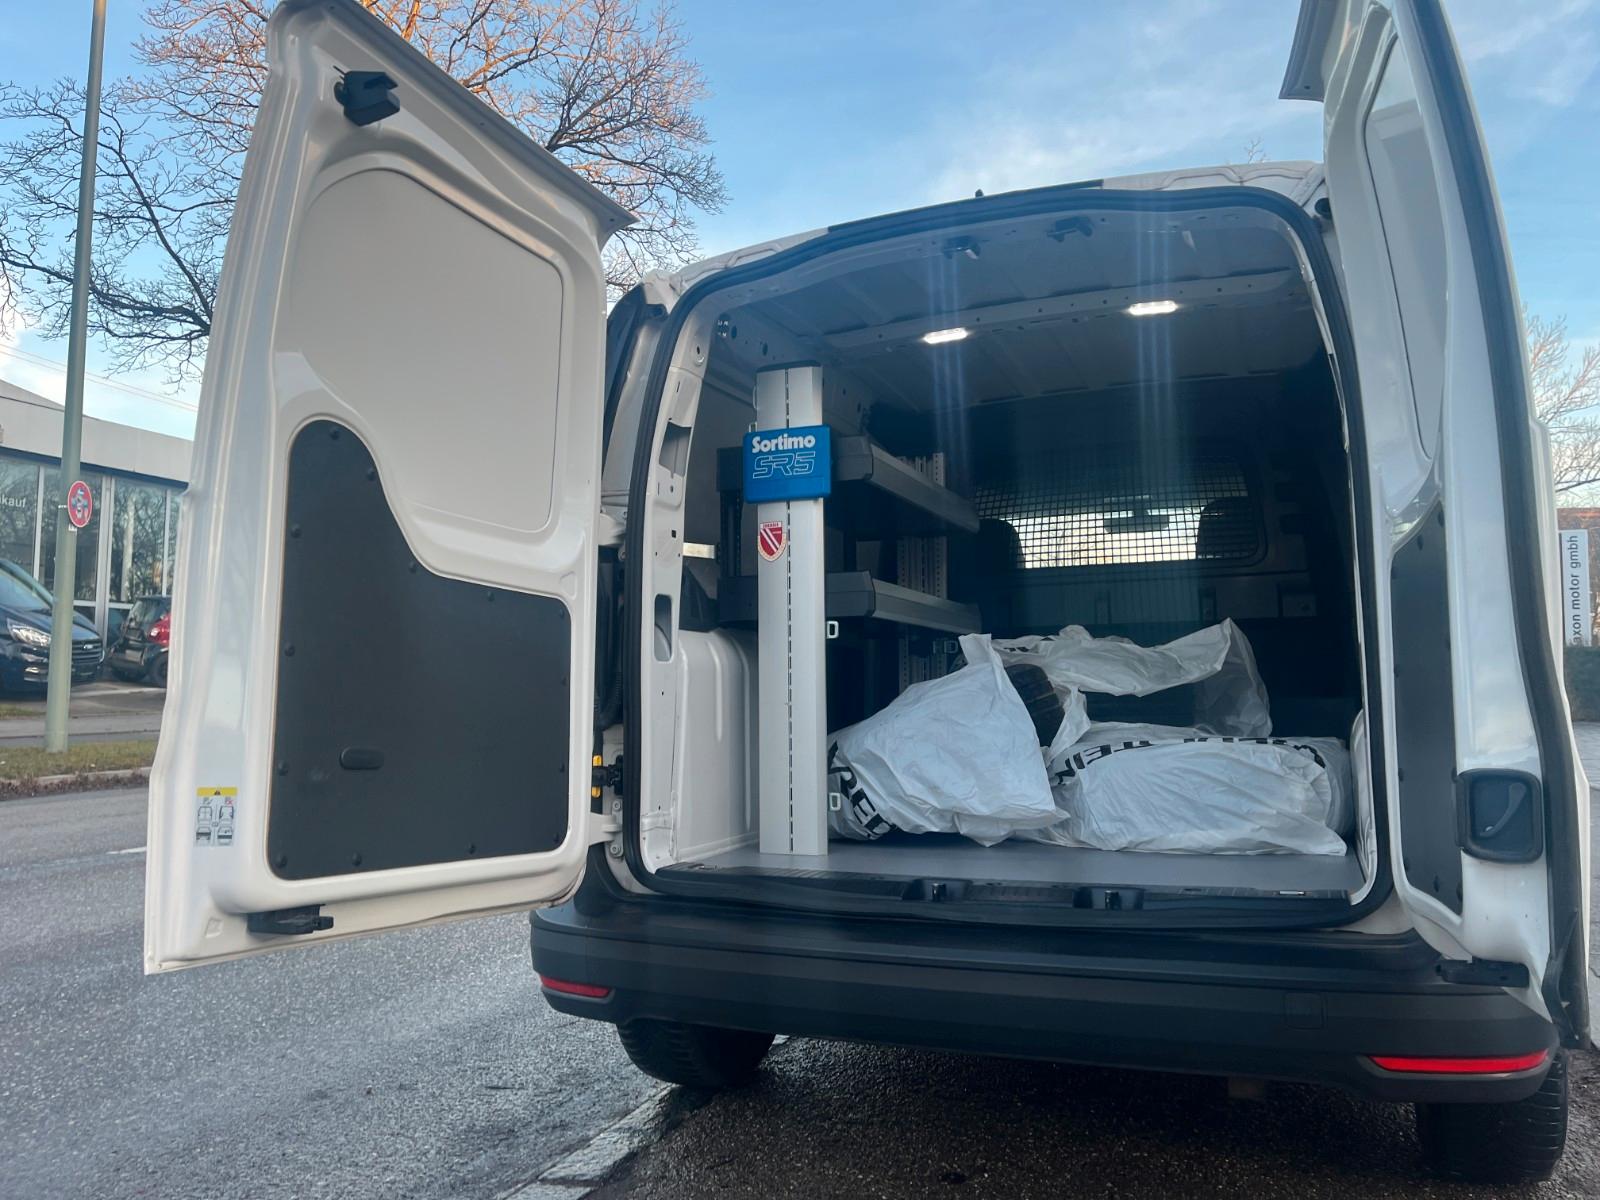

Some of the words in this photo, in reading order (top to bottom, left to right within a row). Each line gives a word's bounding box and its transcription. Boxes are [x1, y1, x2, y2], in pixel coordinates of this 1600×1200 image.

[752, 434, 816, 453] Sortimo
[752, 451, 816, 479] SR5
[0, 494, 26, 508] kauf
[1567, 535, 1581, 568] gmbh
[1569, 573, 1580, 609] motor
